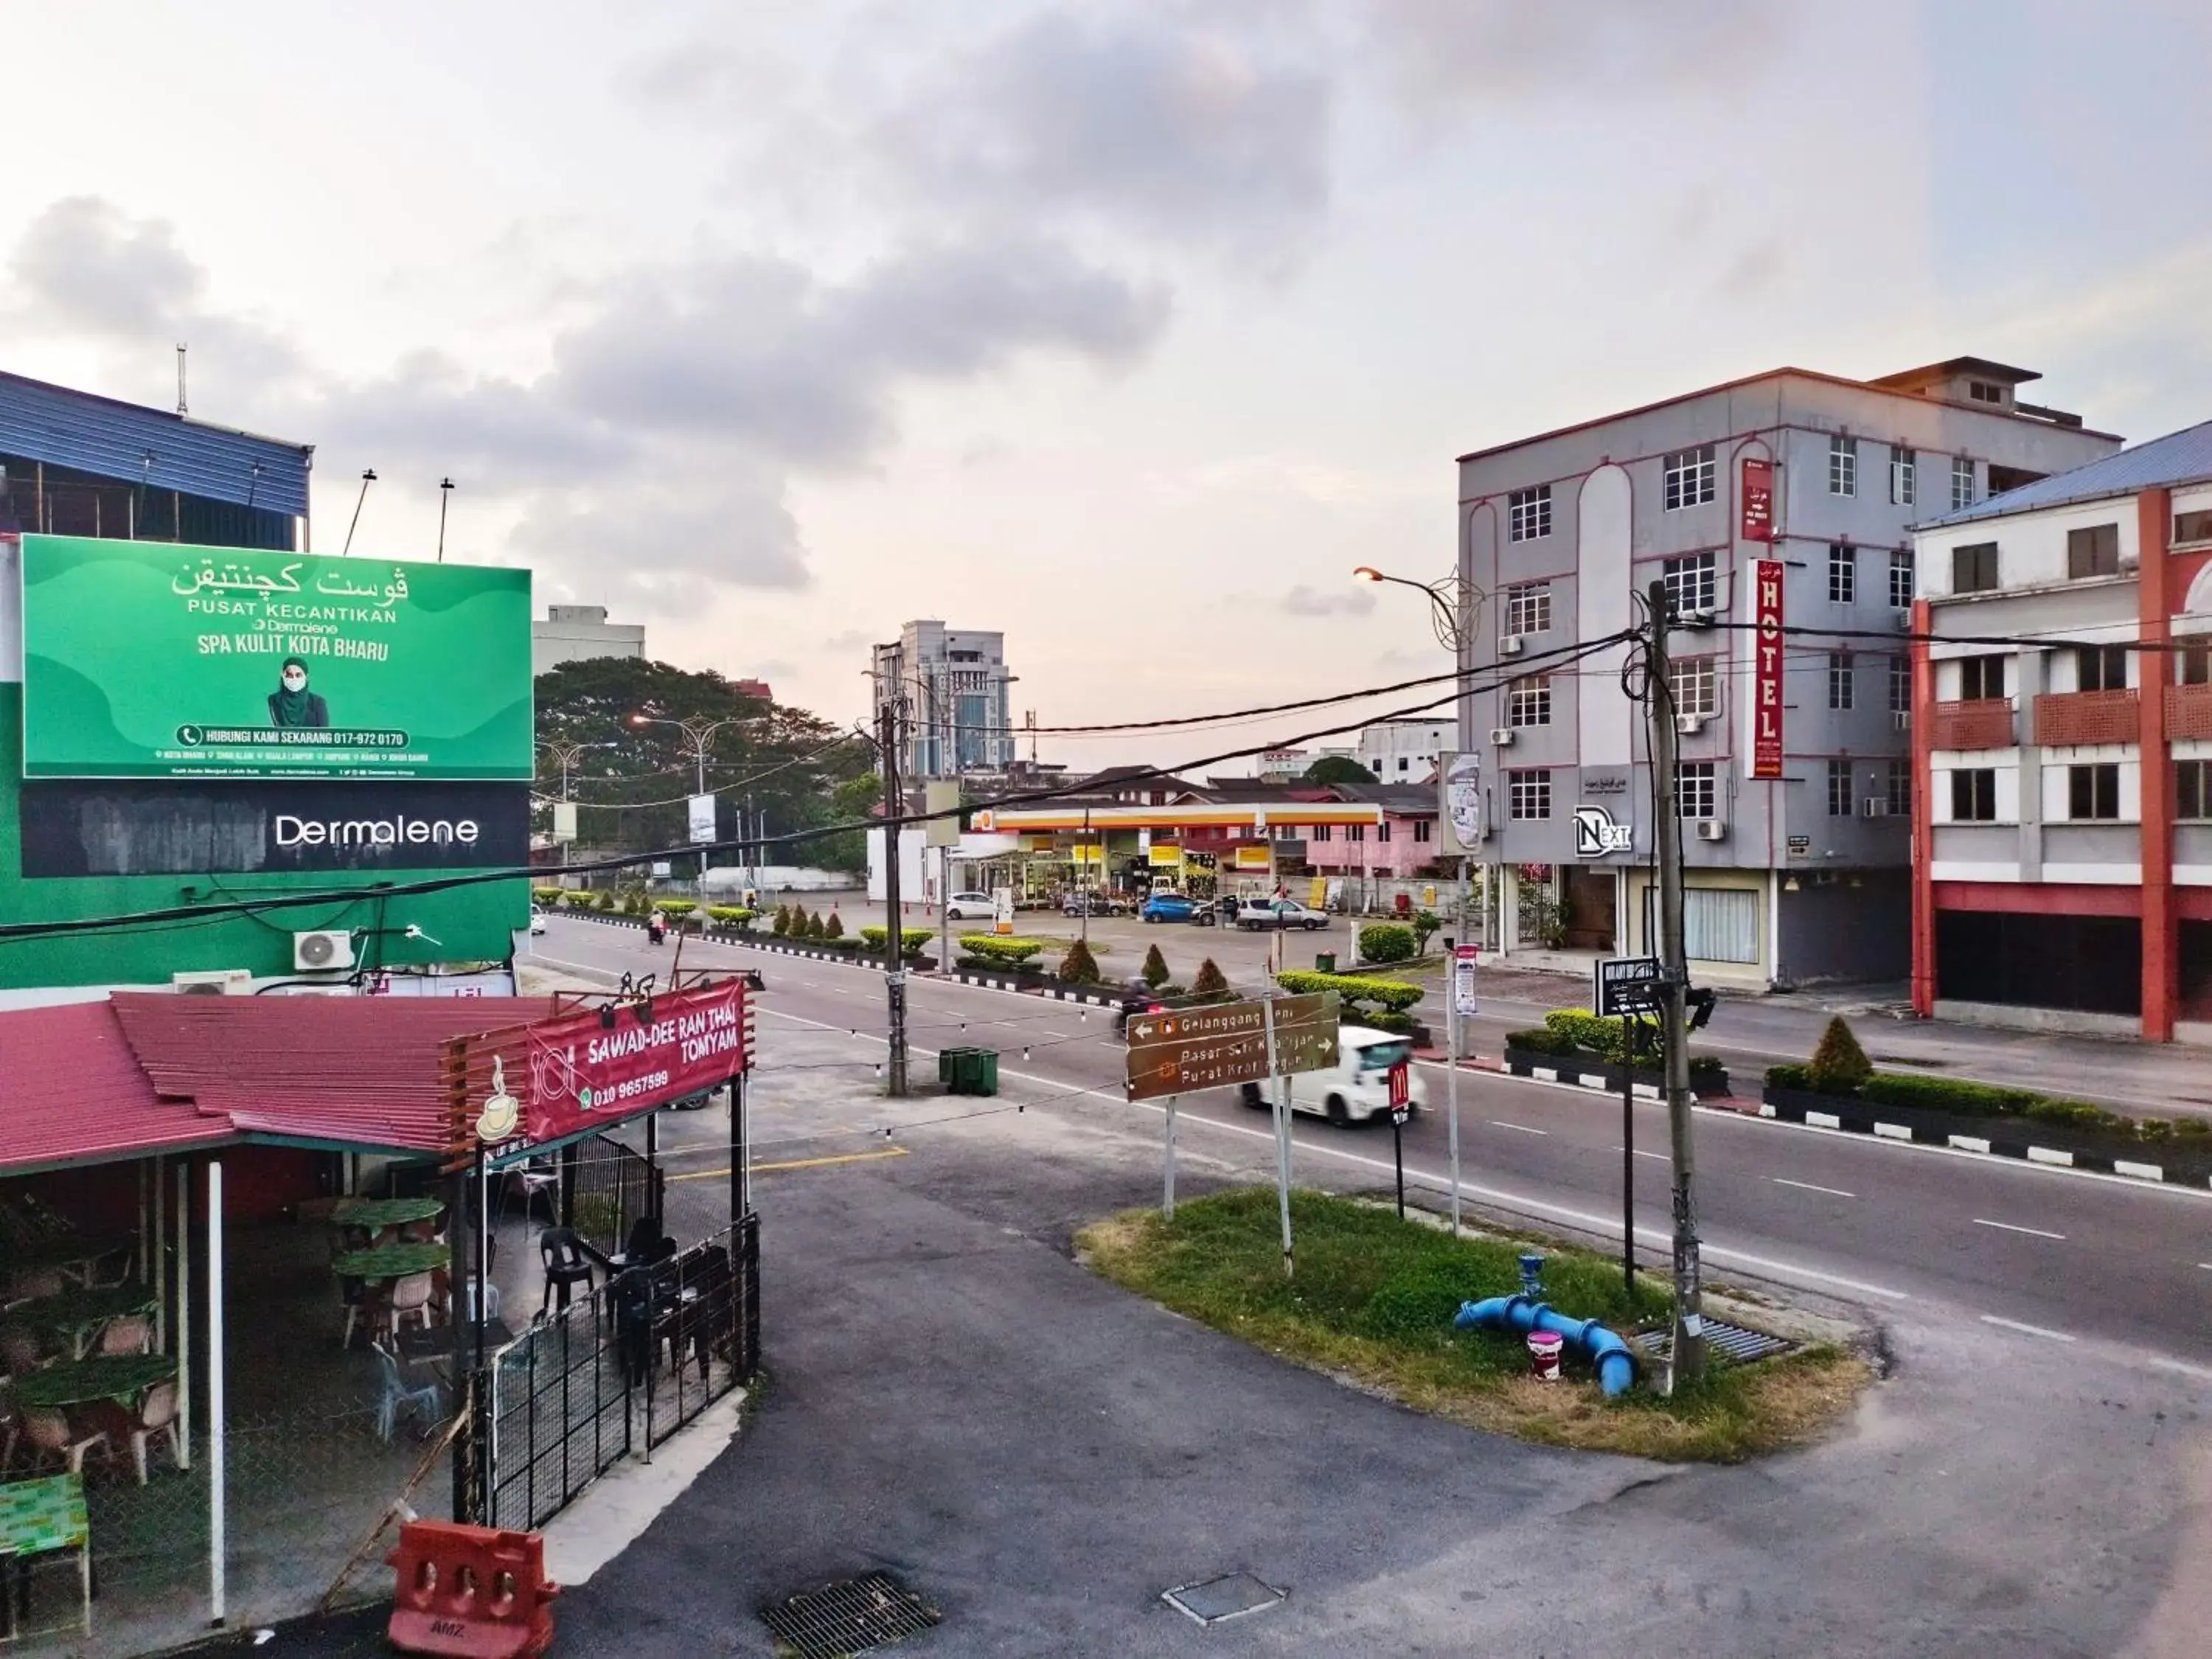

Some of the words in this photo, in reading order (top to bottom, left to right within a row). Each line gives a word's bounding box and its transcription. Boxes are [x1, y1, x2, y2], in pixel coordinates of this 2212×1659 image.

[188, 599, 257, 616] PUSAT
[266, 602, 397, 623] KECANTIKAN
[198, 634, 232, 655] SPA
[236, 634, 283, 653] KULIT
[289, 636, 330, 656] KOTA
[335, 638, 389, 661] BHARU
[1761, 581, 1778, 737] HOTEL
[206, 731, 251, 742] HUBUNGI
[253, 731, 279, 743] KAMI
[281, 731, 332, 744] SEKARANG
[334, 732, 376, 745] 017-972
[378, 733, 403, 745] 0170
[276, 815, 479, 845] Dermalene
[588, 1020, 675, 1063] SAWAD-DEE
[678, 1015, 706, 1040] RAN
[707, 1002, 737, 1030] THAI
[1182, 1012, 1261, 1031] Gelanggang
[681, 1030, 737, 1063] TOMYAM
[594, 1087, 616, 1107] 010
[430, 1620, 465, 1638] AMZ
